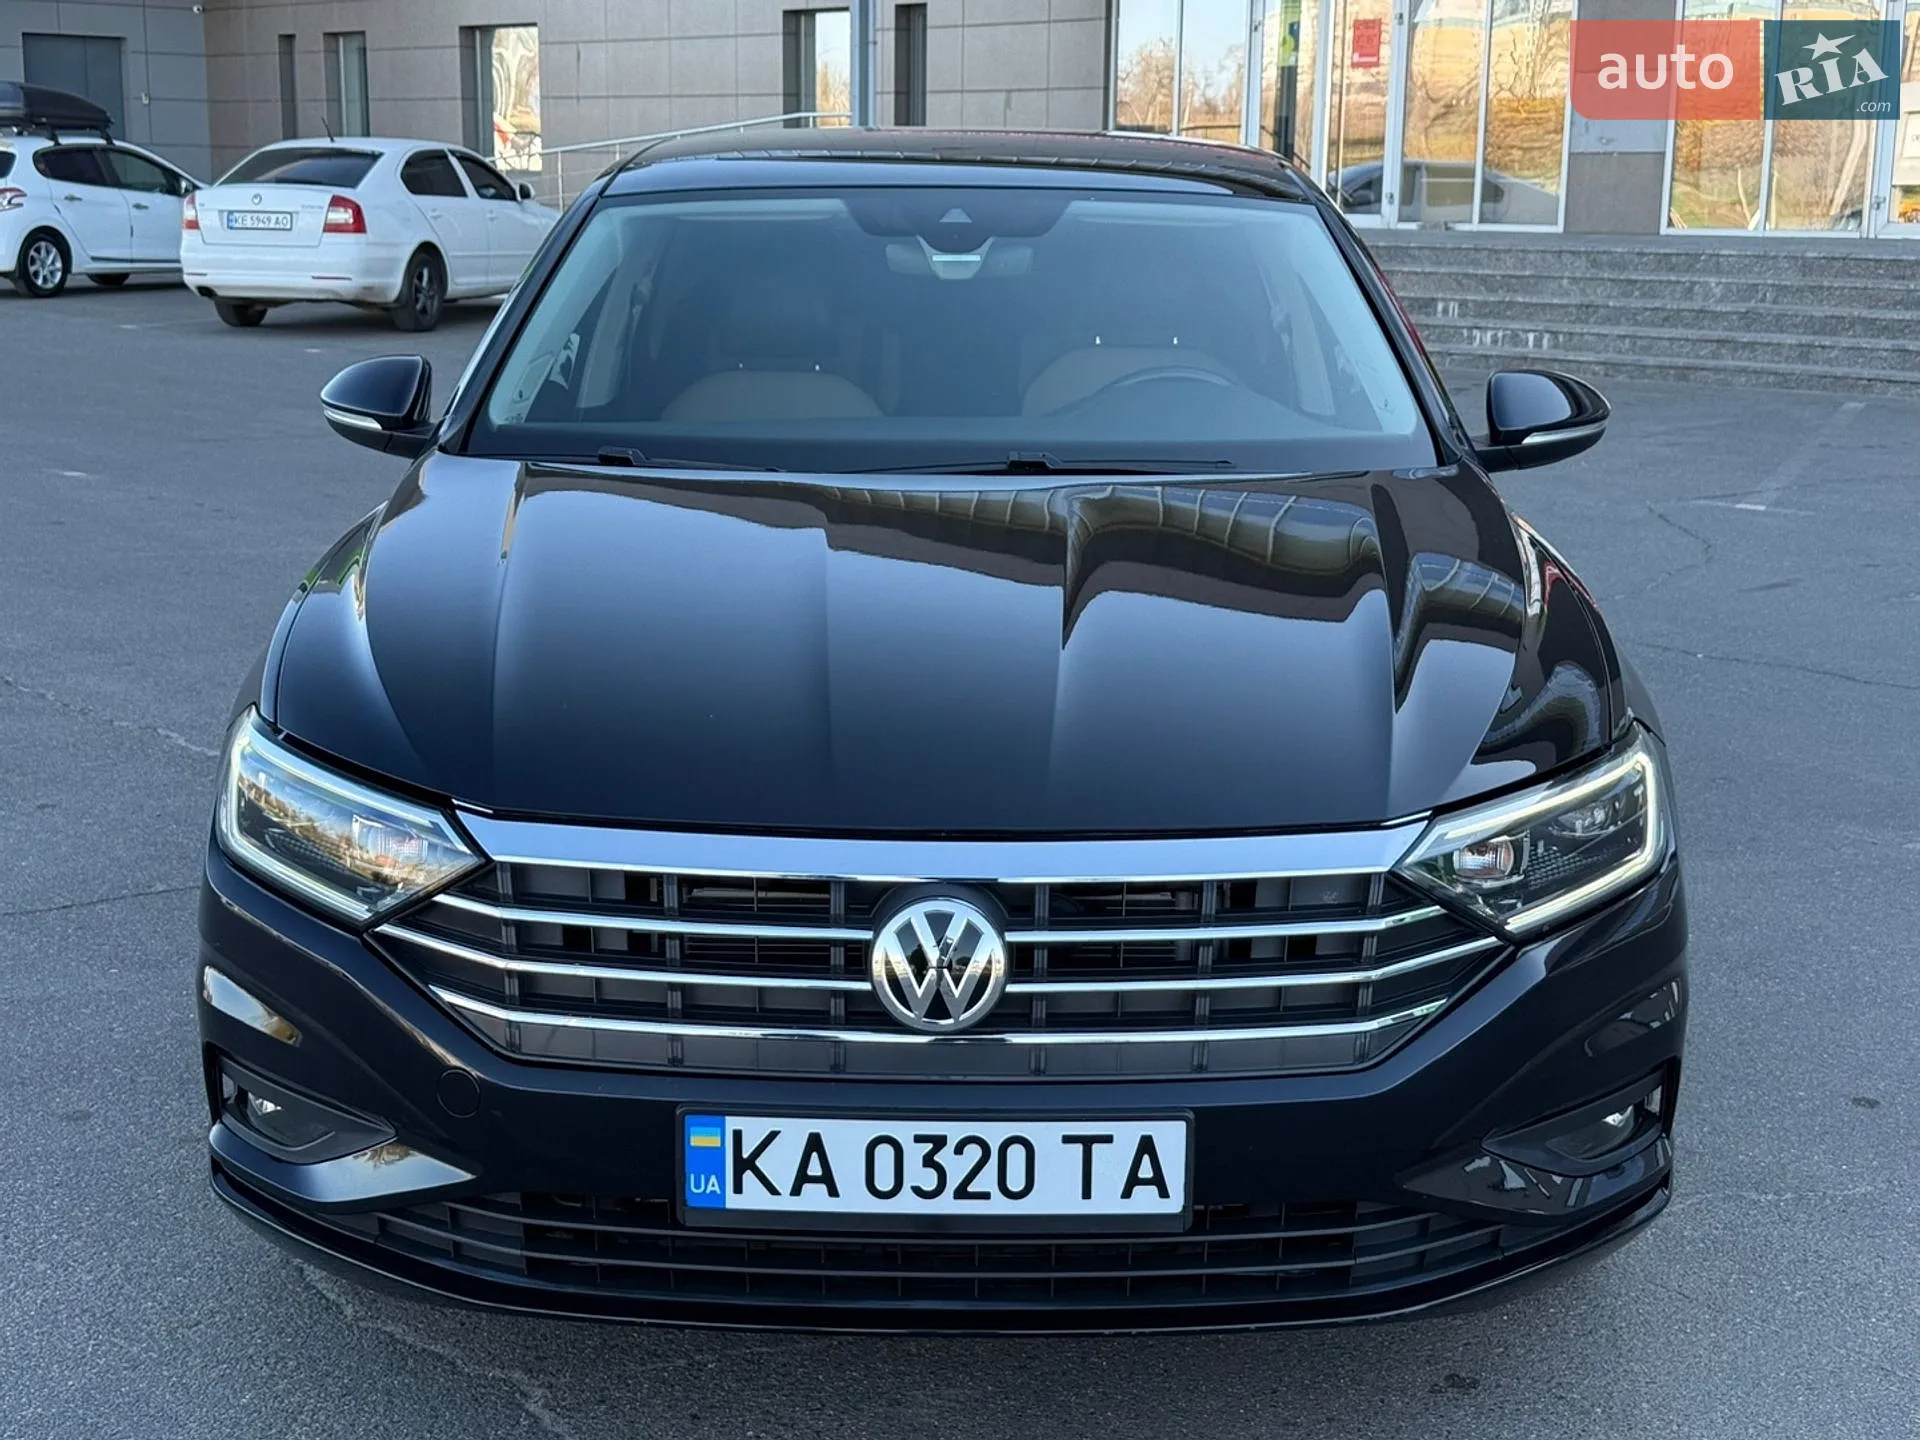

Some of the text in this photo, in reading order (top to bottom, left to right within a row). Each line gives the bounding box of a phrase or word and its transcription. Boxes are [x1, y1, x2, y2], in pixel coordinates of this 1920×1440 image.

[234, 214, 248, 226] KE
[250, 215, 272, 226] 5949
[731, 1128, 1171, 1200] KA 0320 TA
[690, 1173, 721, 1195] UA
